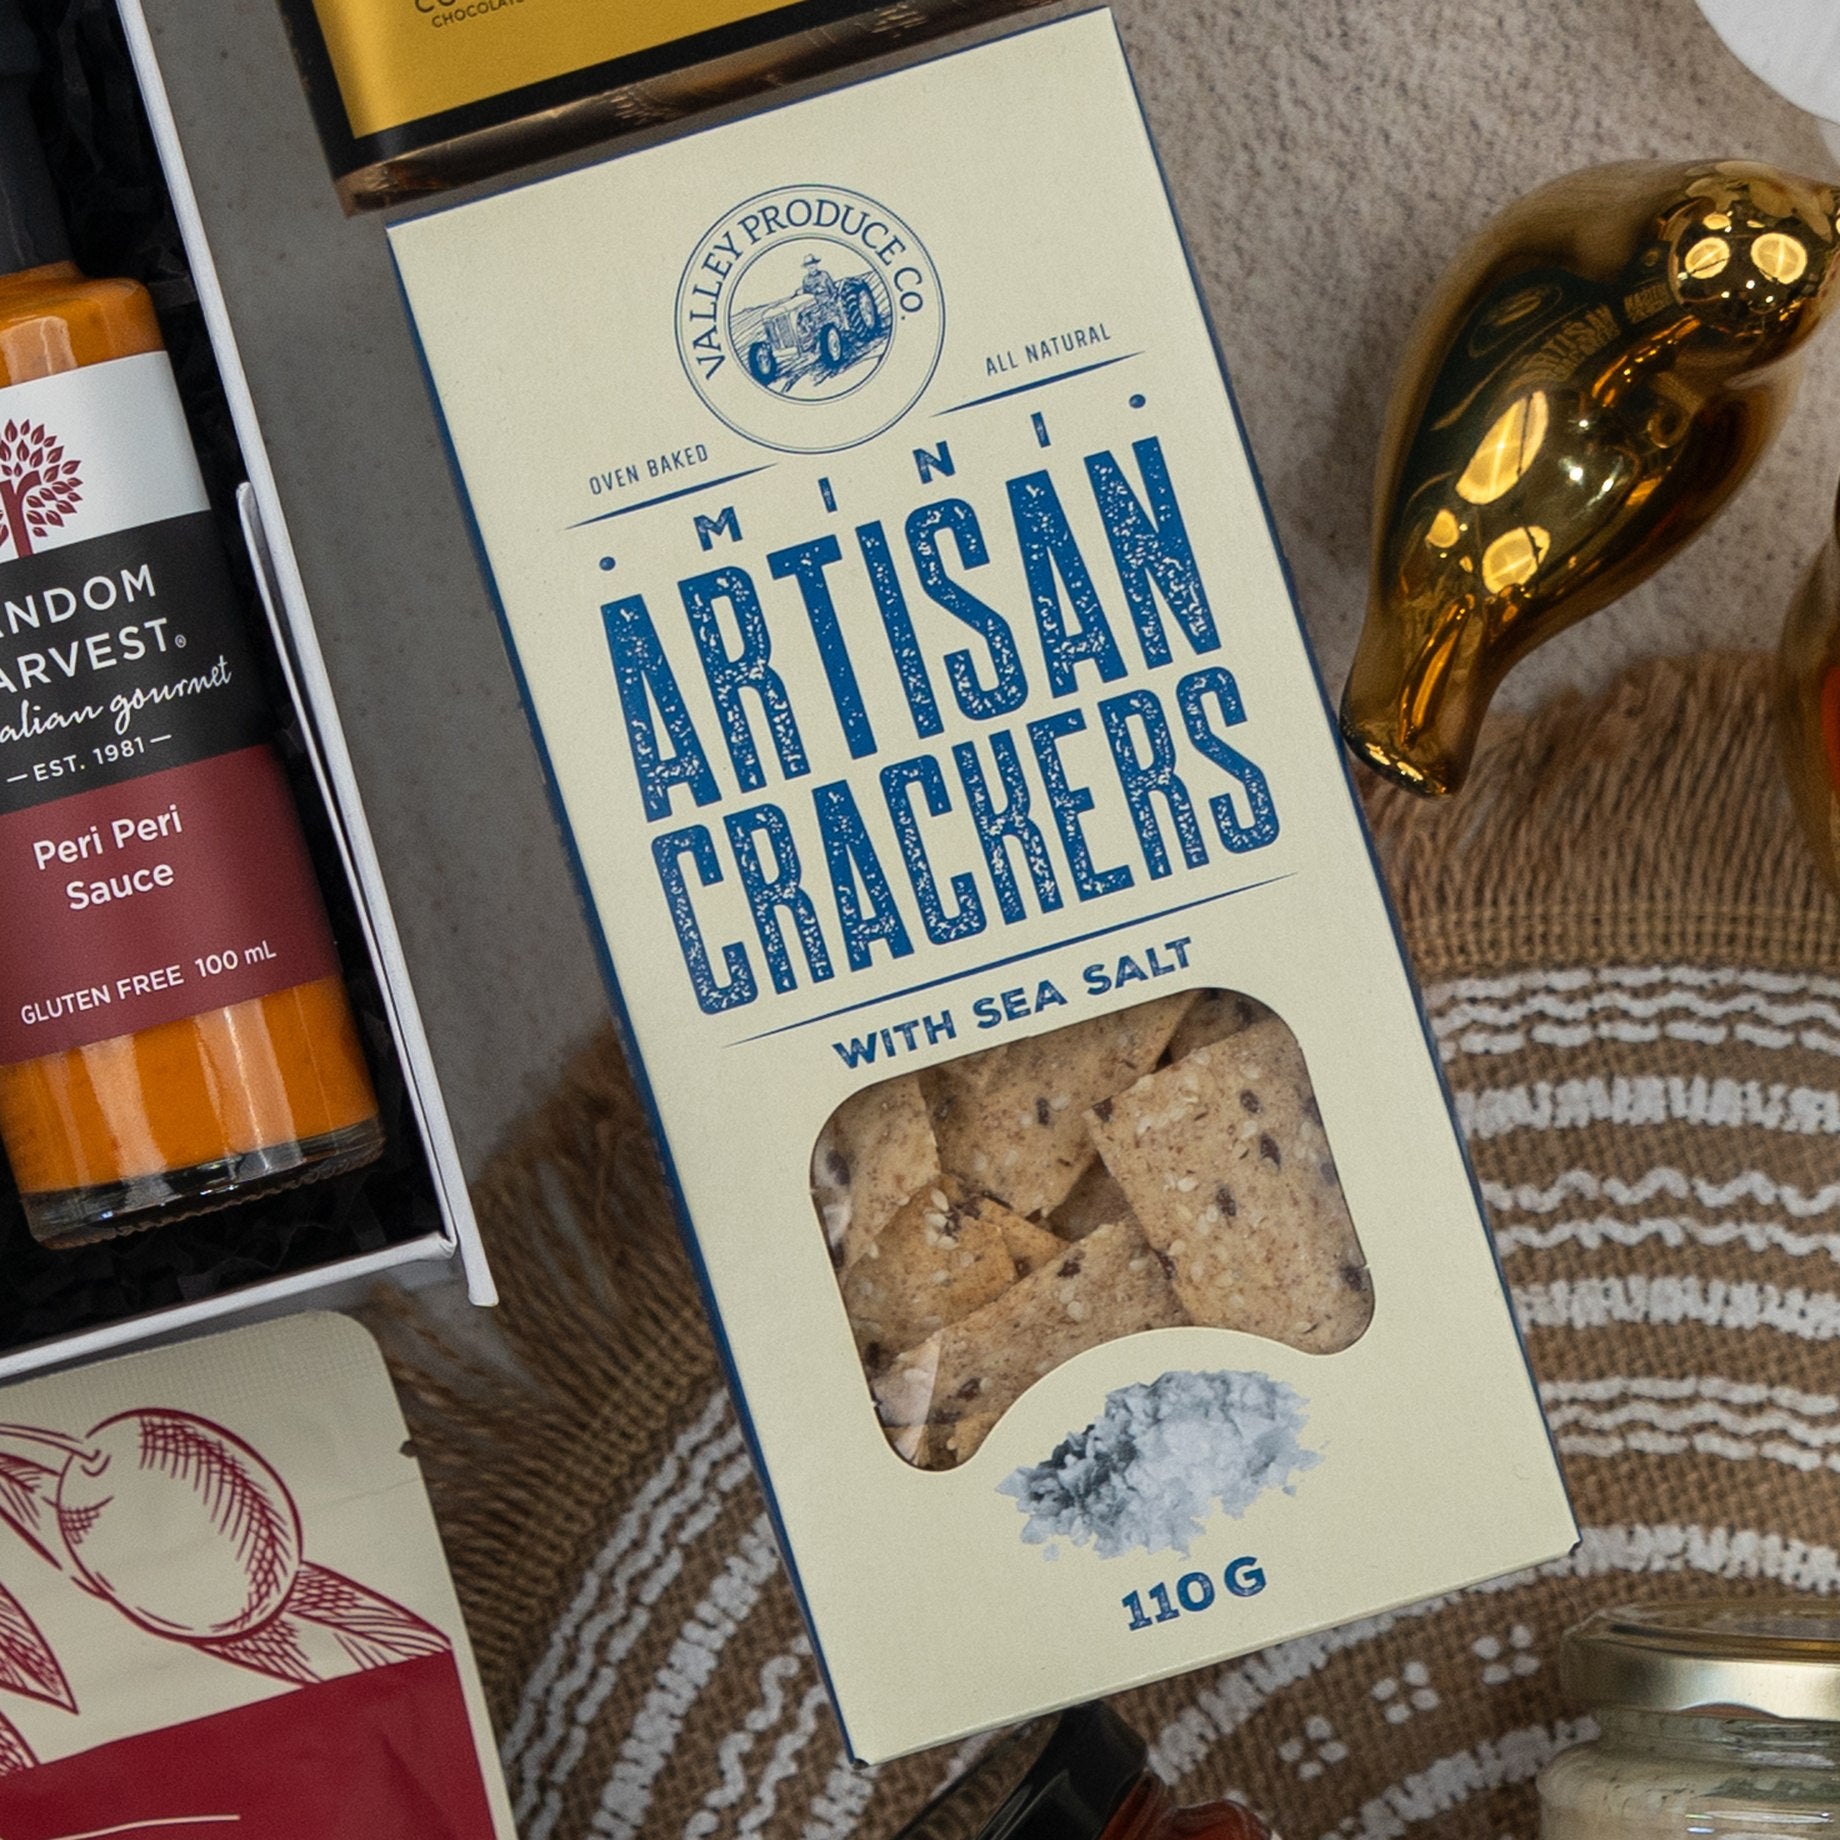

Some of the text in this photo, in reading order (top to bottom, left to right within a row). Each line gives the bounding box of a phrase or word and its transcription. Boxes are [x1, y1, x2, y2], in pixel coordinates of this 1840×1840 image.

[690, 231, 743, 380] VALLEY
[738, 199, 906, 266] PRODUCE
[986, 323, 1111, 376] ALL NATURAL
[589, 444, 708, 495] OVEN BAKED
[601, 436, 1221, 822] ARTISAN
[110, 655, 232, 735] gourmet
[93, 737, 145, 764] 1981
[33, 804, 183, 870] Peri Peri
[650, 666, 1280, 1015] CRACKERS
[66, 864, 174, 909] Sauce
[21, 940, 277, 1025] GLUTEN FREE 100 mL
[832, 937, 1191, 1069] WITH SEA SALT
[1122, 1556, 1267, 1631] 110 G
